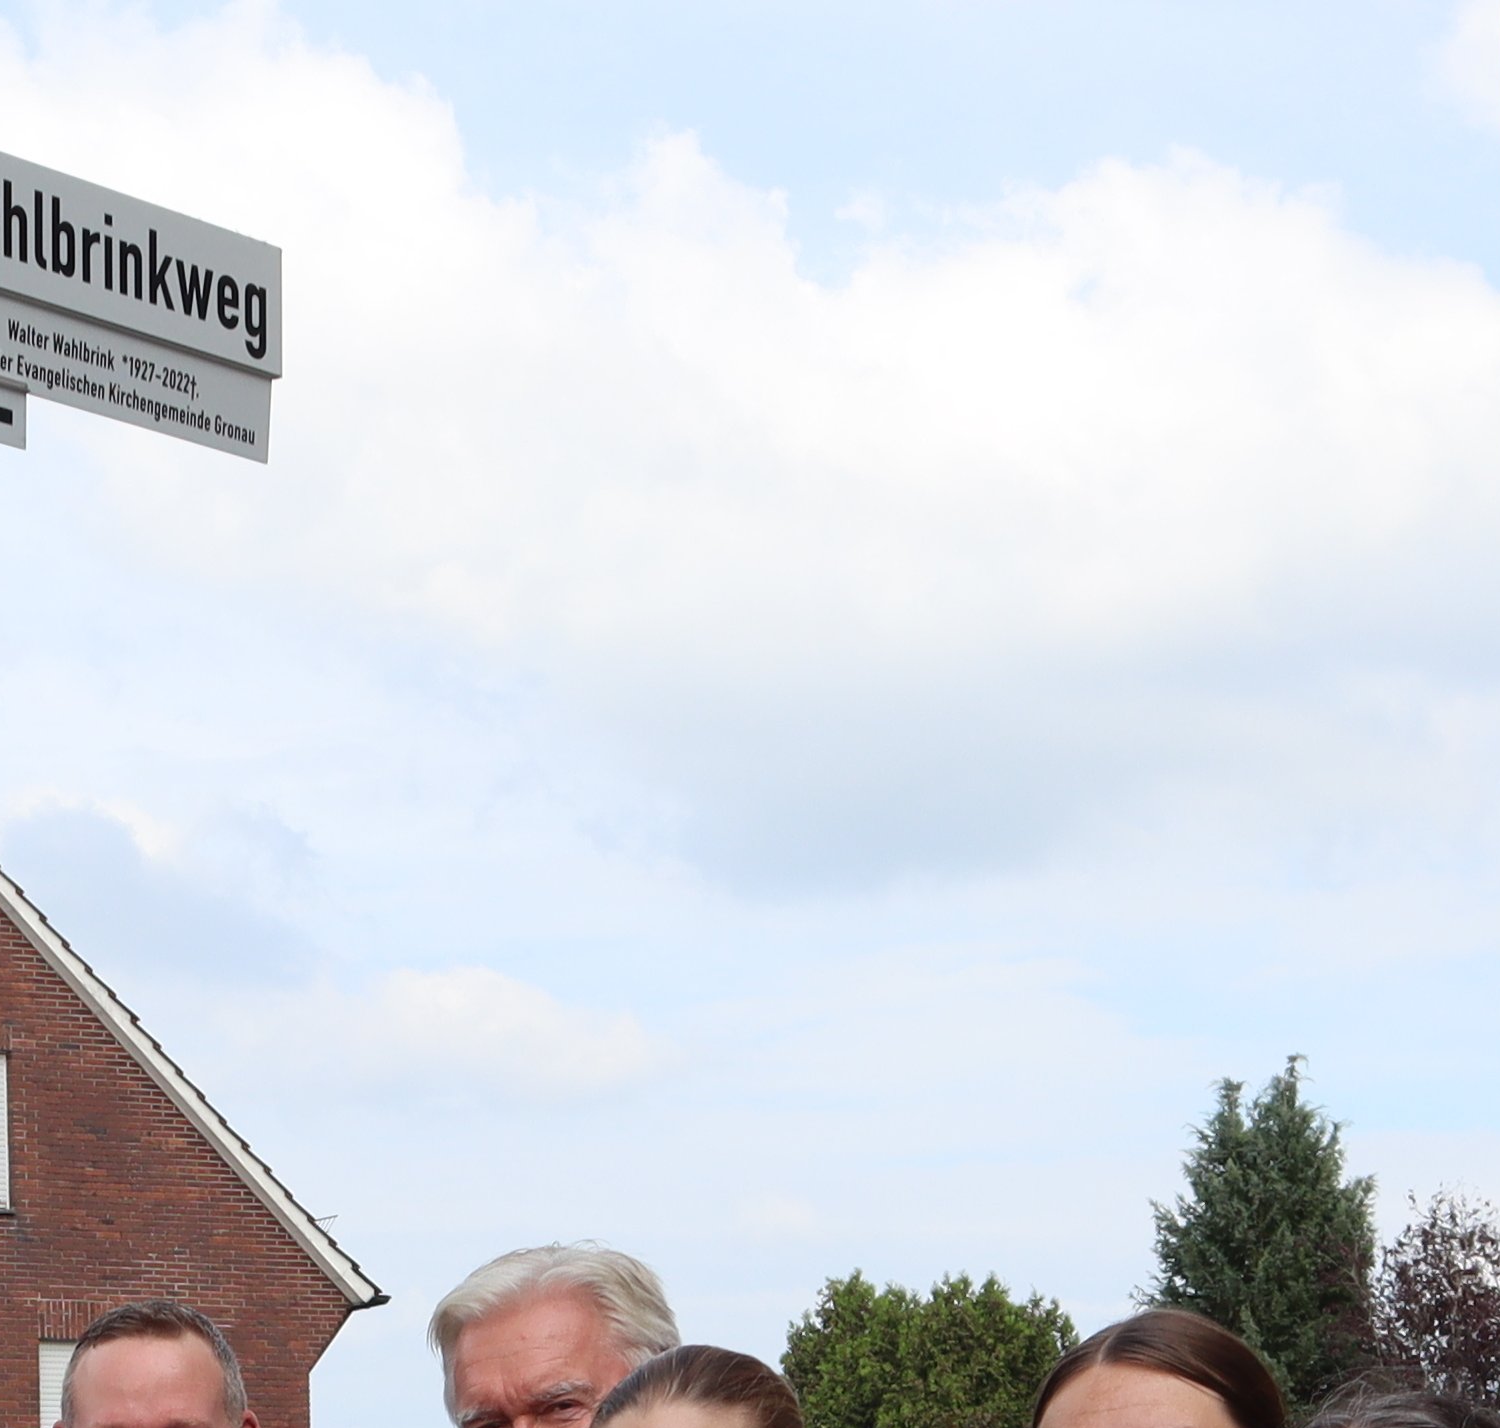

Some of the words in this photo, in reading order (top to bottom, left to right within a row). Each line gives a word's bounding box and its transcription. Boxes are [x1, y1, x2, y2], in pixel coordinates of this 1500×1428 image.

[8, 318, 50, 350] Walter
[53, 333, 115, 371] Wahlbrink
[17, 355, 105, 401] Evangelischen
[109, 382, 211, 432] Kirchengemeinde
[214, 414, 256, 446] Gronau
